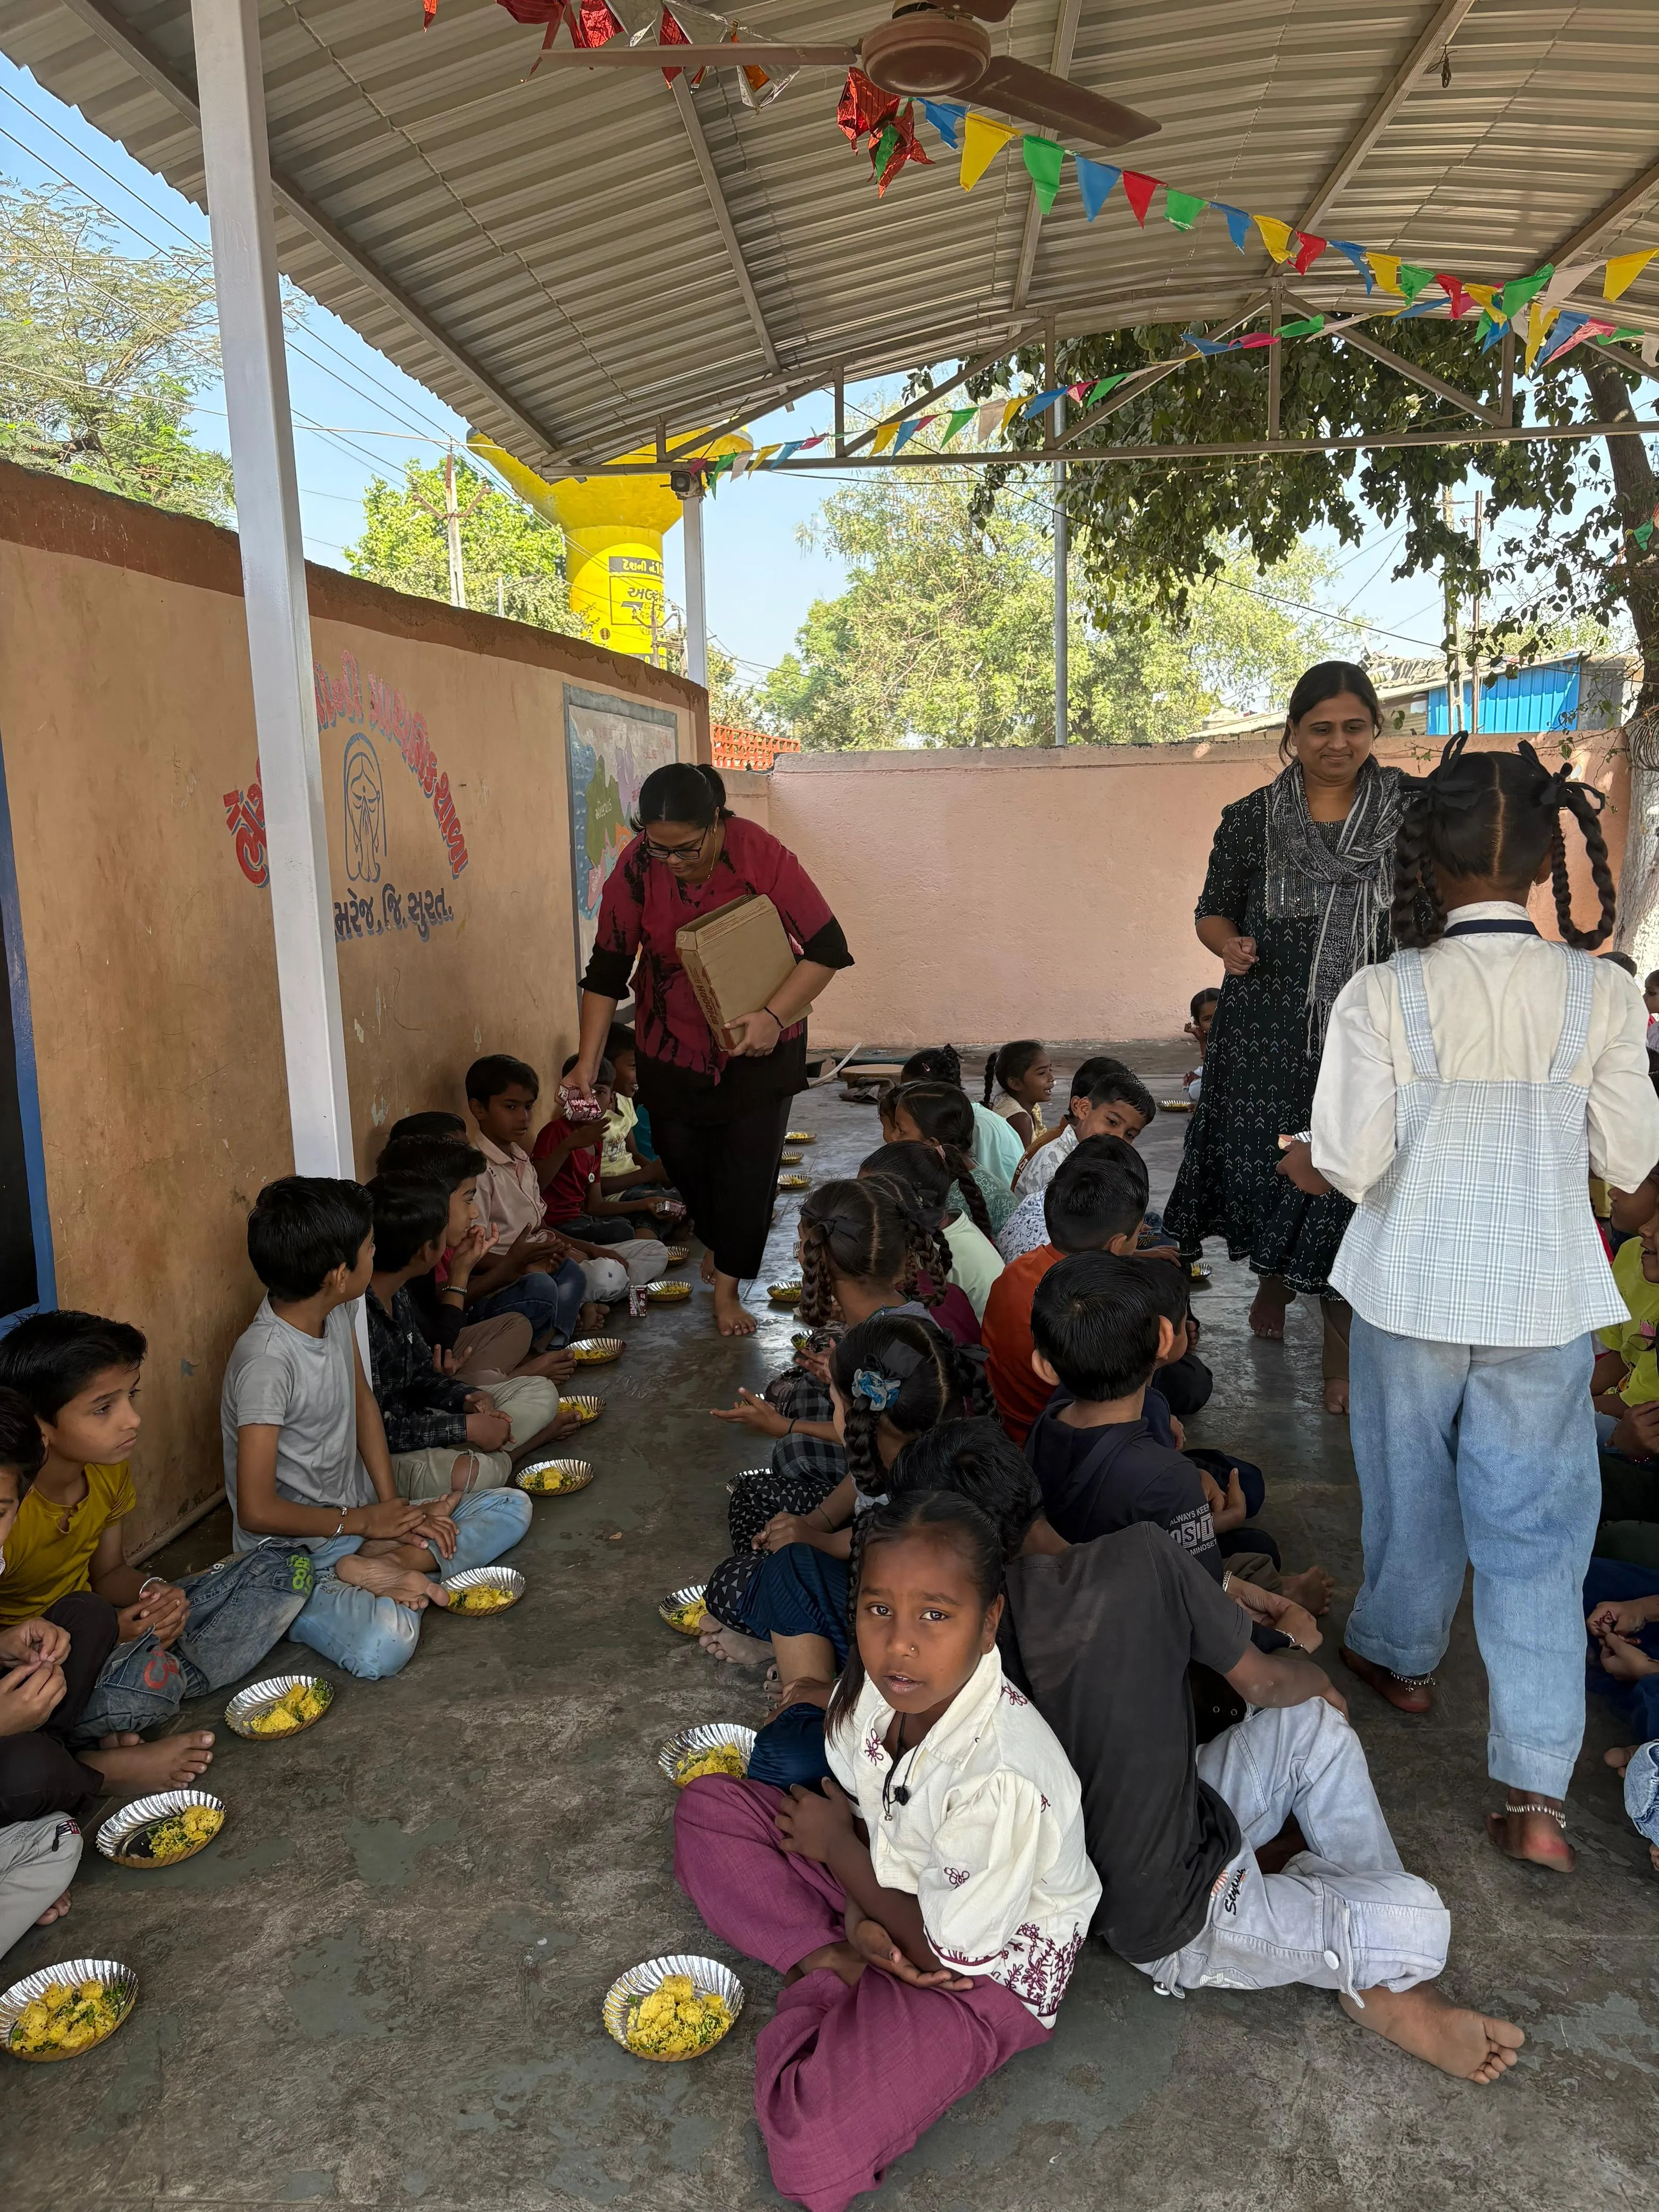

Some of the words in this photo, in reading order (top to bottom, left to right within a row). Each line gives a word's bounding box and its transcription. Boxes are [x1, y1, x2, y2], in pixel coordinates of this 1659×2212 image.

[333, 887, 383, 939] મરેજ,
[1166, 1512, 1214, 1548] OSIT
[1170, 1510, 1196, 1527] ALWAYS
[1196, 1503, 1210, 1516] KEEP
[1189, 1539, 1217, 1556] MINDSET
